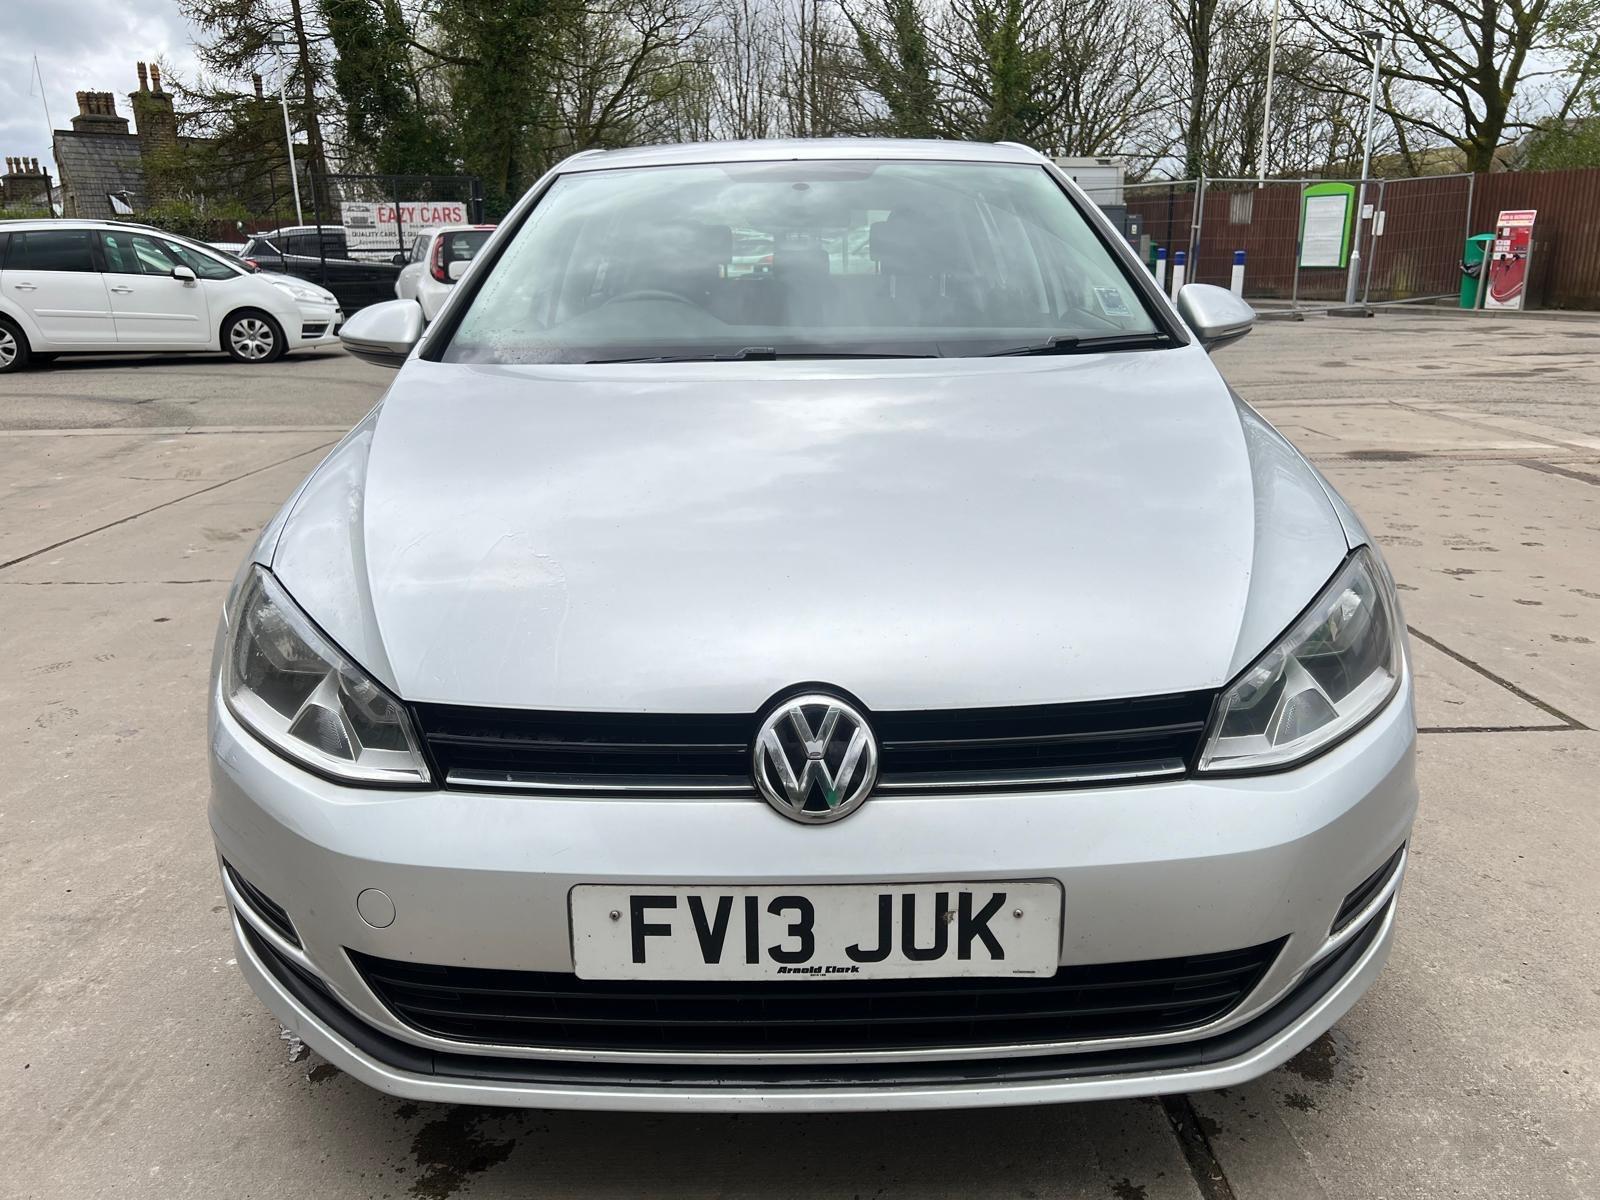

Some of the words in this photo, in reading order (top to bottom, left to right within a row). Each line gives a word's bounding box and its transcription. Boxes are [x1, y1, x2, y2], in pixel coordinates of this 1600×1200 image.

[378, 207, 415, 224] EAZY
[420, 206, 462, 223] CARS
[629, 894, 816, 964] FV13
[845, 891, 1008, 961] JUK
[776, 966, 823, 974] Arnold
[825, 965, 860, 974] Clark
